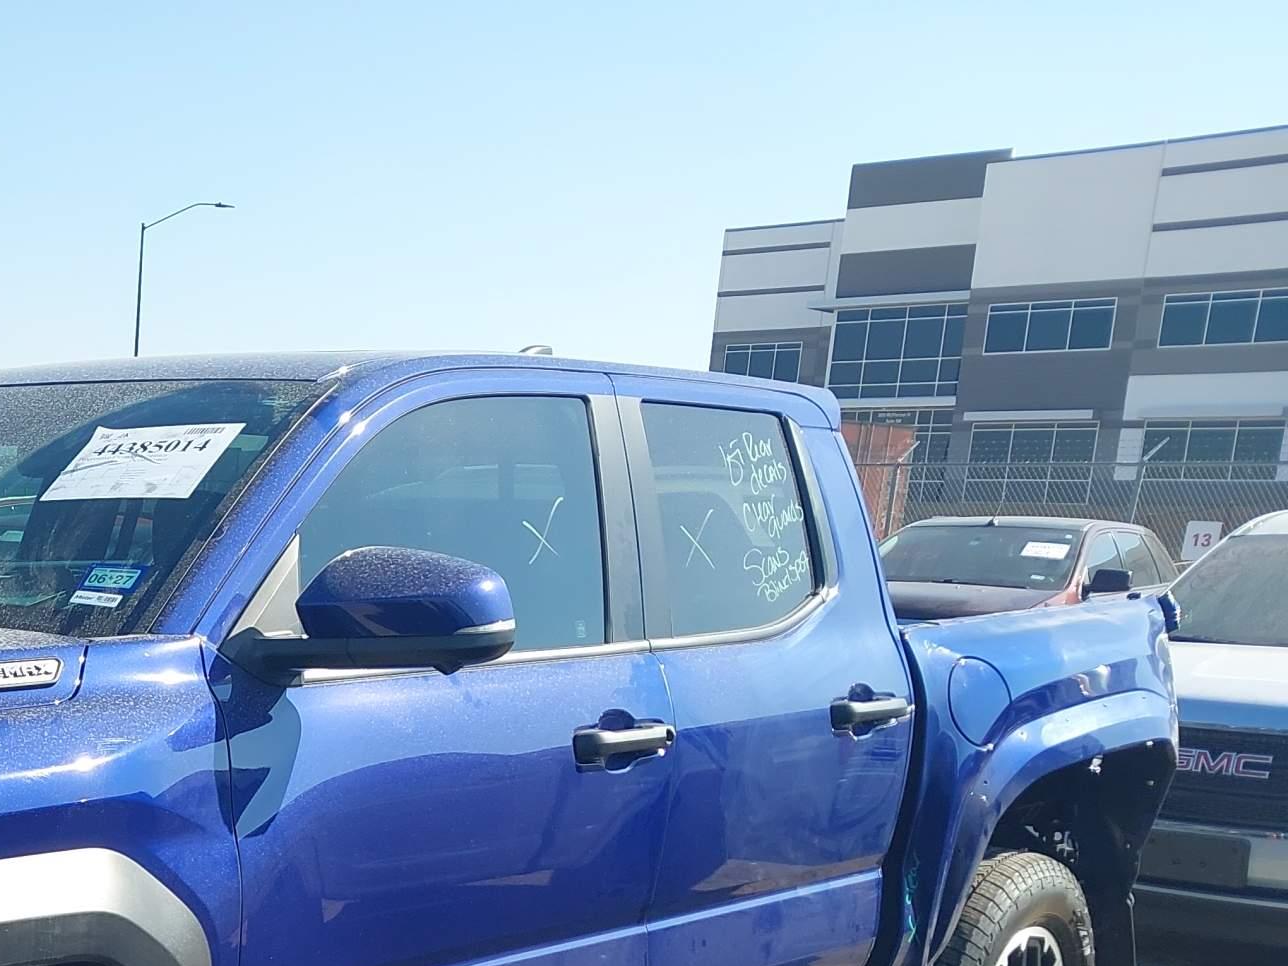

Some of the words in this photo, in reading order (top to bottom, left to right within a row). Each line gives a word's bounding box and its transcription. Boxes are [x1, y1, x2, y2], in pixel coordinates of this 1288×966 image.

[93, 438, 212, 457] 44385014
[1193, 533, 1212, 547] 13
[88, 573, 108, 584] 06
[113, 574, 135, 585] 27
